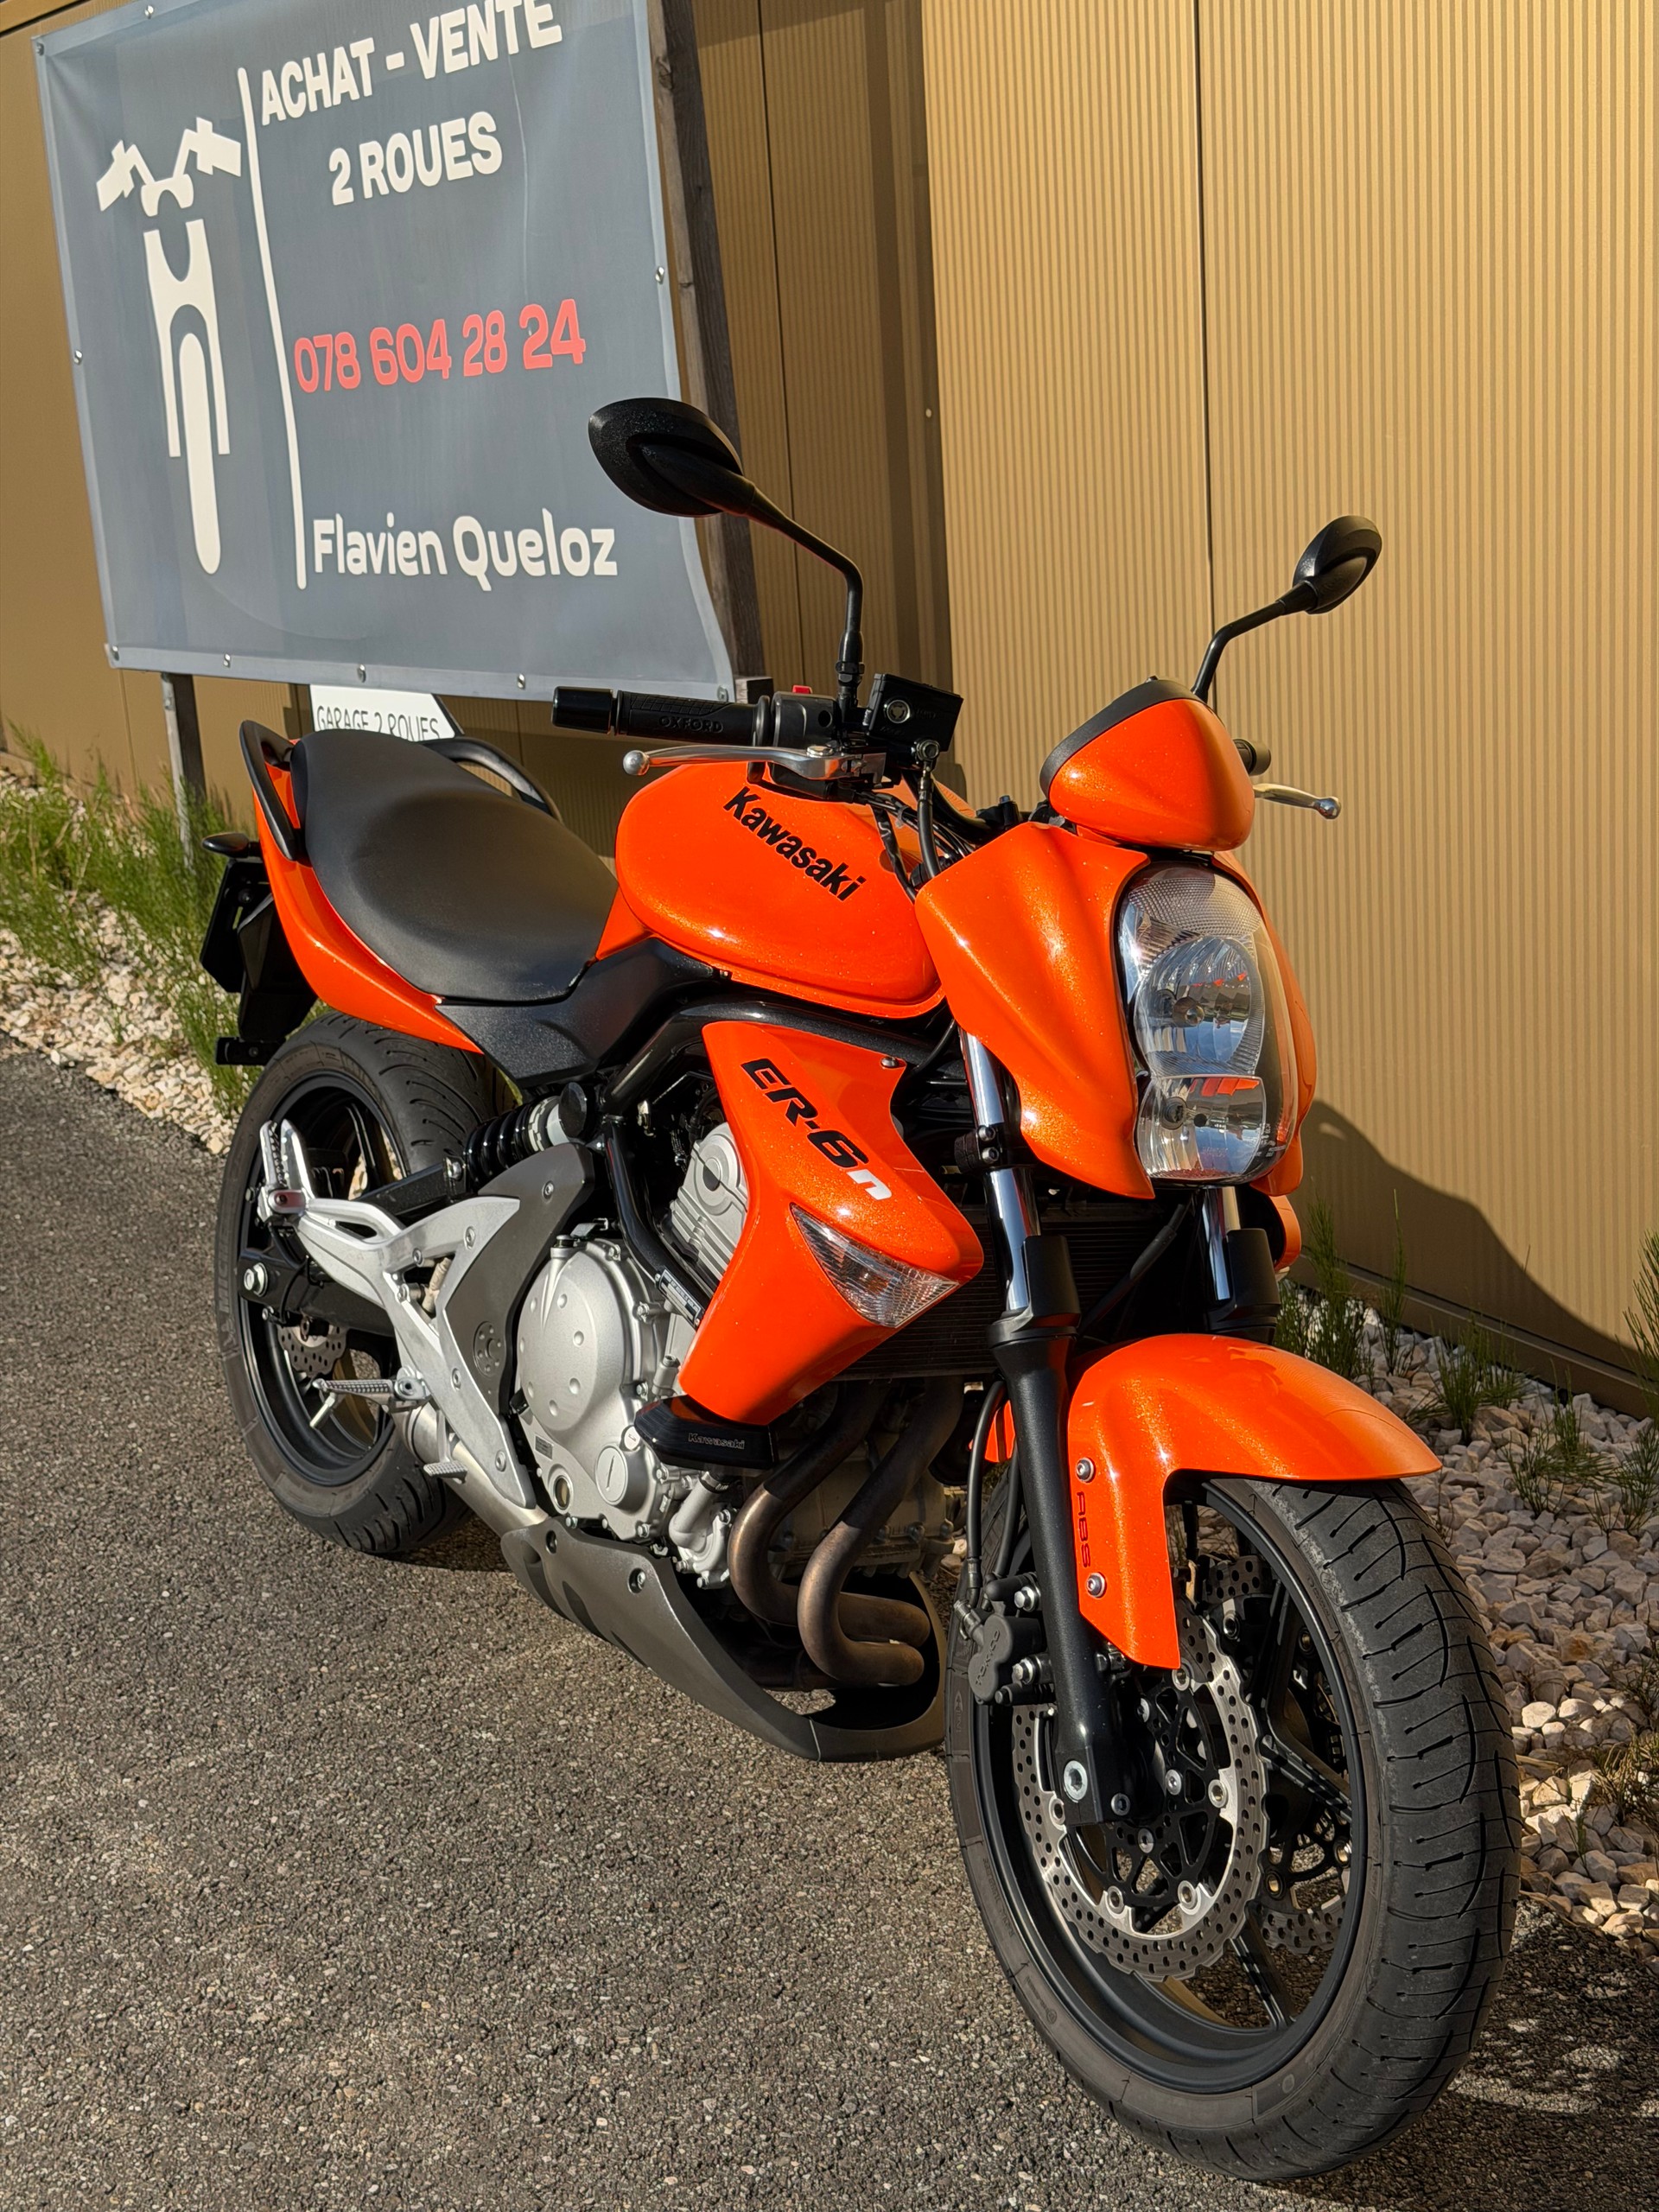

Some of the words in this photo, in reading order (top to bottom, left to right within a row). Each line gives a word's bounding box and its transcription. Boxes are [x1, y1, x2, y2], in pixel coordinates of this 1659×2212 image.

[262, 37, 375, 126] ACHAT
[410, 0, 563, 79] VENTE
[329, 148, 354, 206] 2
[359, 111, 503, 199] ROUES
[294, 332, 361, 393] 078
[370, 319, 452, 386] 604
[461, 310, 507, 378] 28
[519, 299, 586, 370] 24
[313, 512, 448, 576] Flavien
[453, 508, 618, 591] Queloz
[316, 705, 369, 730] GARAGE
[388, 713, 441, 742] ROUES
[658, 715, 724, 734] OXFORD
[723, 786, 867, 902] Kawasaki
[741, 1058, 893, 1201] ER-6n
[688, 1432, 746, 1451] Kawasaki
[1077, 1491, 1091, 1568] ABS
[975, 1630, 1001, 1686] TOKICO
